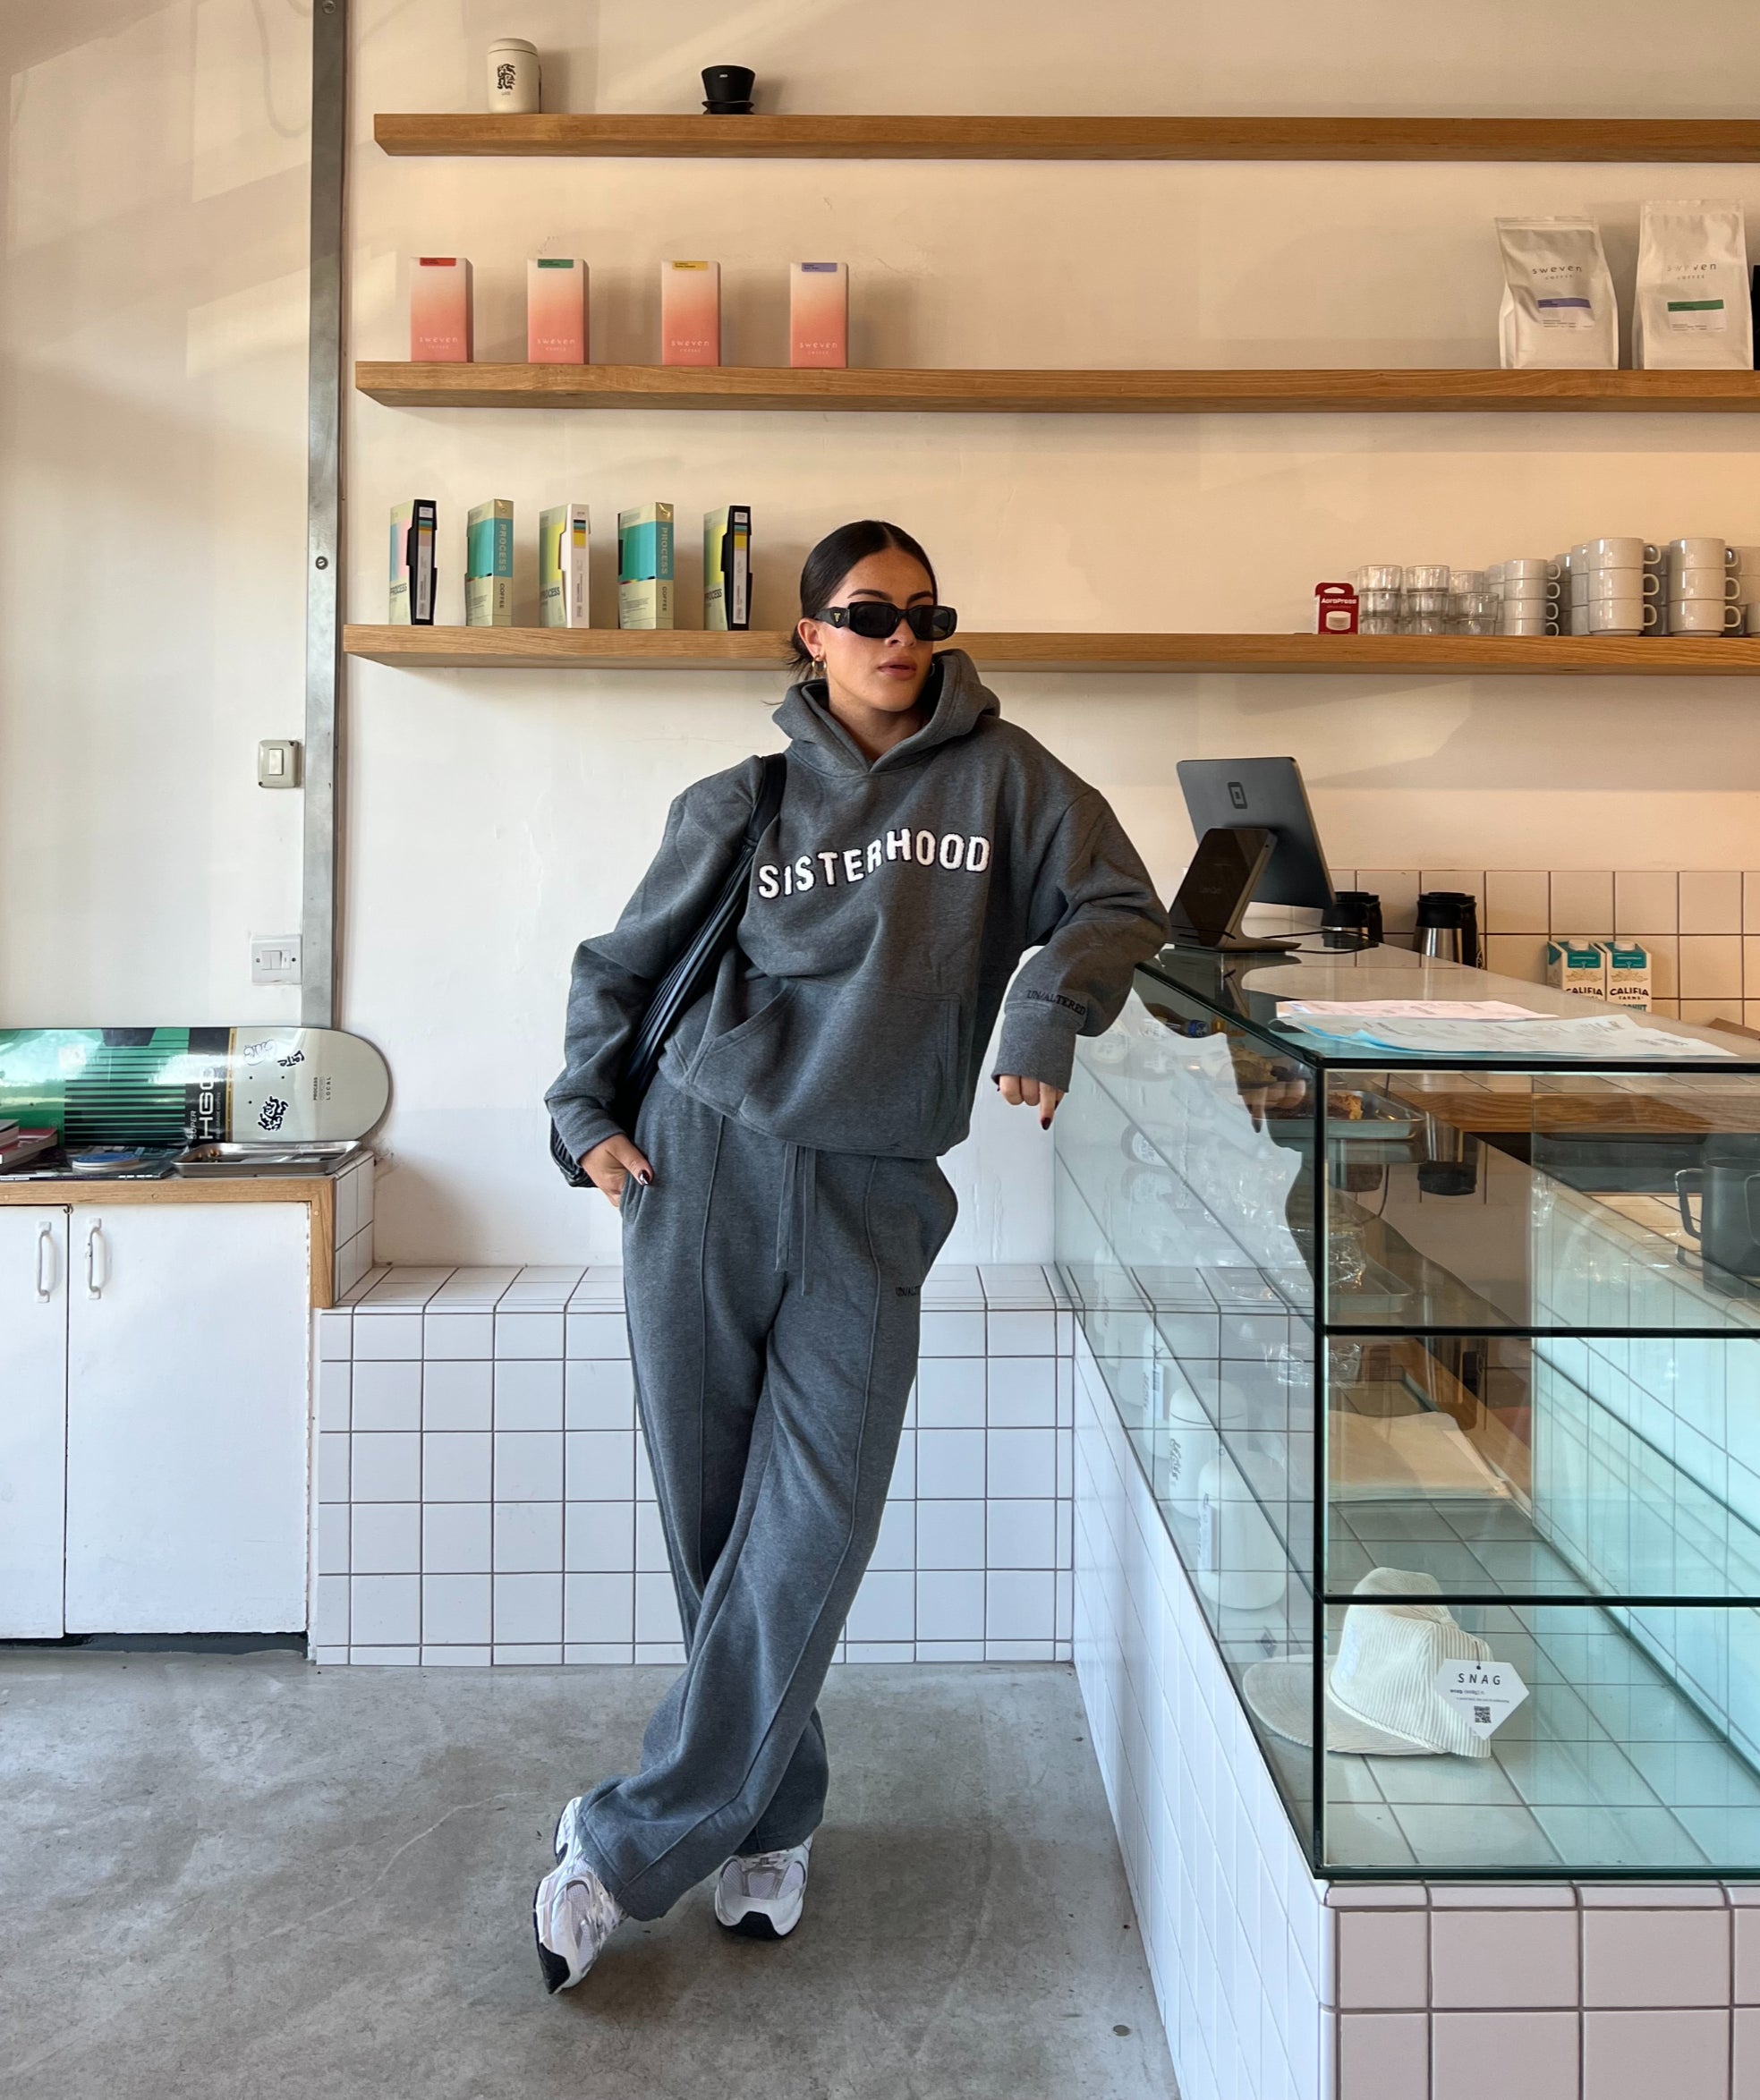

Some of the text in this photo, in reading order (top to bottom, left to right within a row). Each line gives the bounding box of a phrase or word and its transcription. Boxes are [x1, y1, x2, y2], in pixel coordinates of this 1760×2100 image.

[1532, 265, 1582, 275] sweven
[1667, 263, 1717, 271] sweven
[419, 336, 458, 344] sweven
[660, 527, 668, 574] PROCESS
[757, 827, 991, 900] SISTERHOOD
[1610, 987, 1649, 996] CALIFIA
[189, 1110, 198, 1140] SUPER
[1458, 1672, 1501, 1685] SNAG
